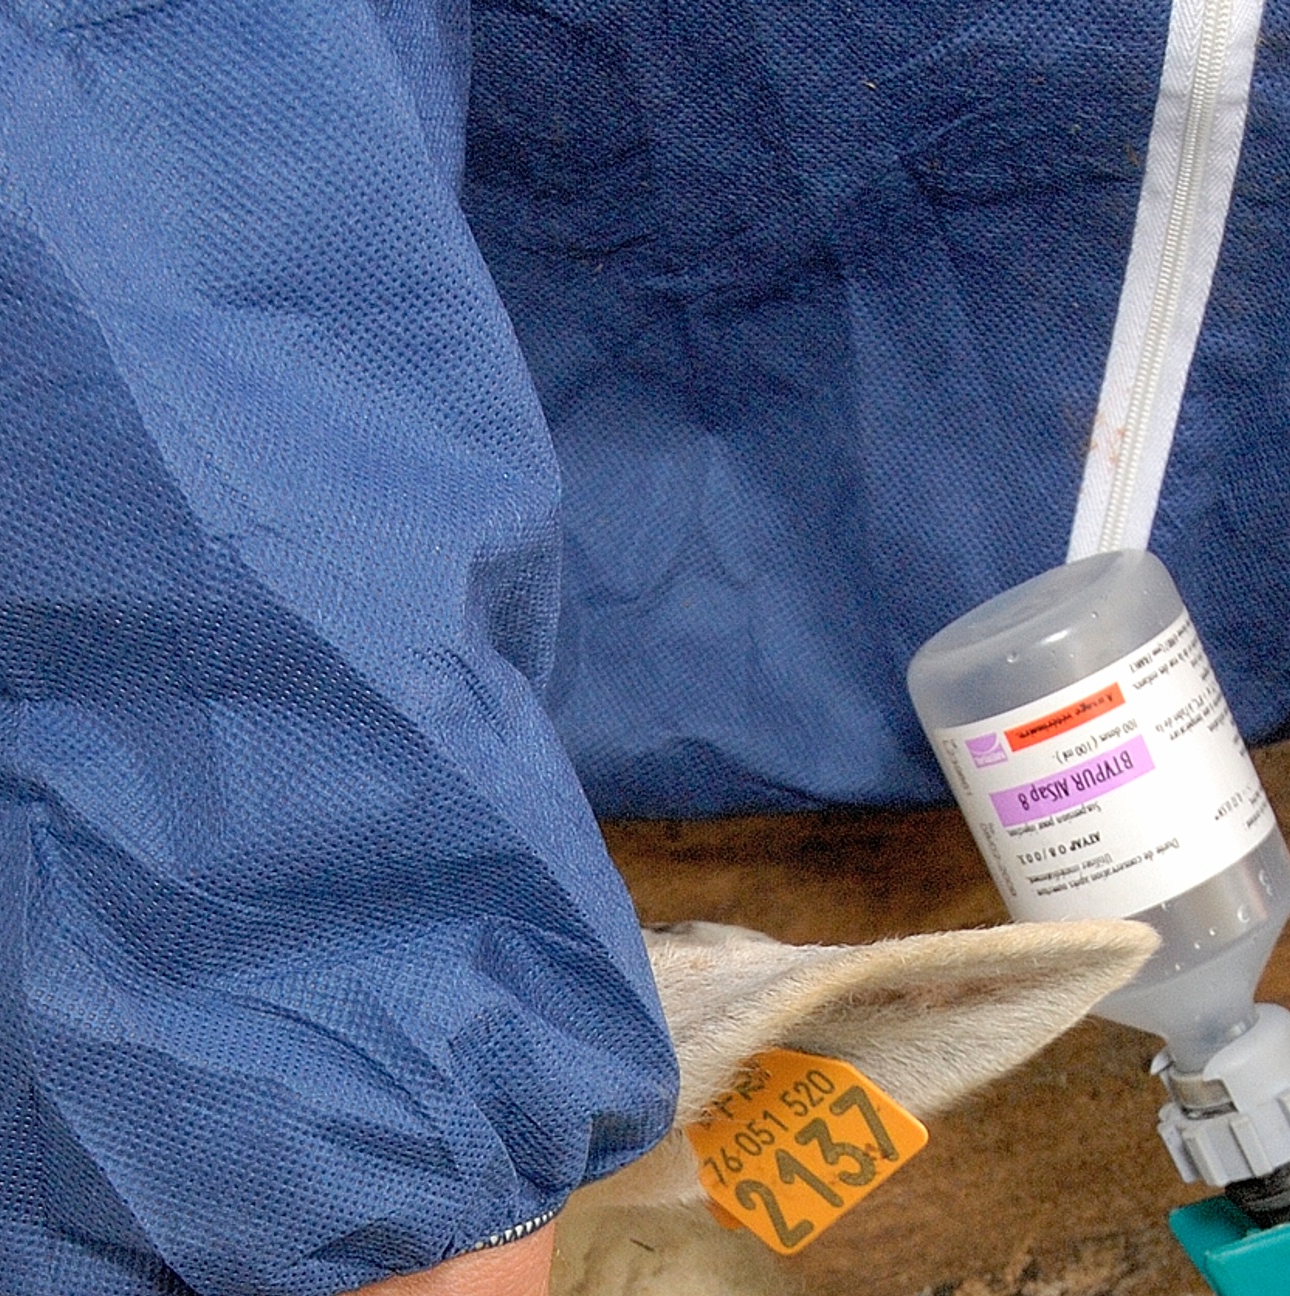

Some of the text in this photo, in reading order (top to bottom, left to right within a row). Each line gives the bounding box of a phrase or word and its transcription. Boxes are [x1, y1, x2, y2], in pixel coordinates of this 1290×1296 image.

[1070, 750, 1133, 791] BTVPUR
[1017, 792, 1030, 810] 8
[781, 1069, 835, 1118] 520
[734, 1084, 899, 1249] 2137
